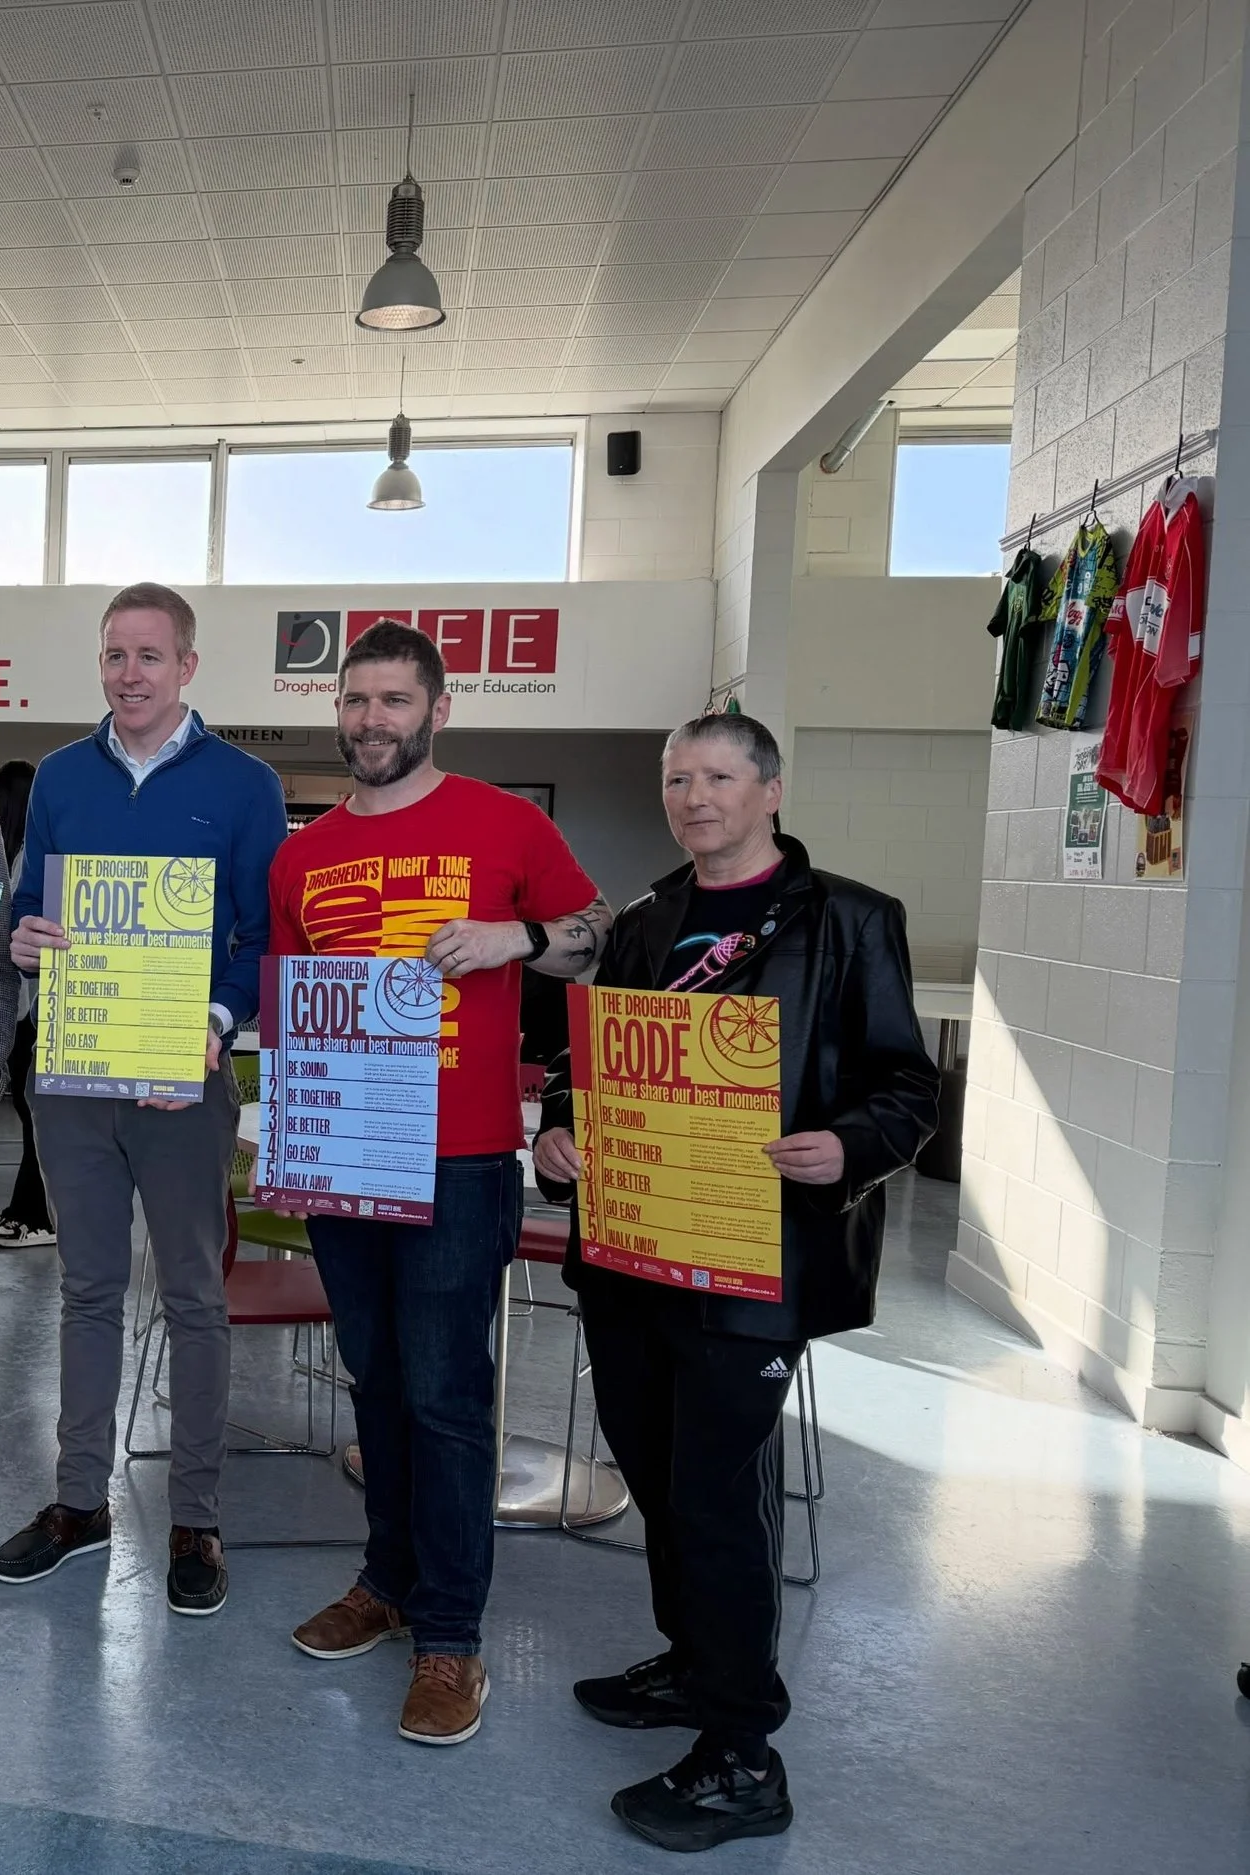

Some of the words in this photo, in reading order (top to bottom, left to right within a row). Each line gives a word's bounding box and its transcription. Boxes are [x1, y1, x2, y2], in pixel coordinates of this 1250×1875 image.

[285, 612, 541, 668] DFE
[274, 679, 337, 696] Droghed
[445, 680, 480, 693] rther
[483, 679, 556, 693] Education
[213, 729, 283, 741] ANTEEN
[75, 859, 93, 876] THE
[96, 859, 149, 879] DROGHEDA
[307, 860, 380, 892] DROGHEDA'S
[388, 856, 430, 878] NIGHT
[438, 856, 472, 878] TIME
[424, 877, 470, 900] VISION
[73, 879, 148, 930] CODE
[69, 929, 87, 944] how
[89, 932, 101, 944] we
[103, 931, 129, 946] share
[130, 934, 144, 946] our
[147, 932, 166, 947] best
[169, 933, 212, 949] moments
[69, 954, 79, 968] BE
[81, 955, 107, 969] SOUND
[291, 961, 309, 978] THE
[313, 961, 369, 980] DROGHEDA
[67, 981, 78, 994] BE
[79, 982, 119, 997] TOGETHER
[291, 982, 368, 1034] CODE
[601, 993, 622, 1014] THE
[626, 995, 691, 1020] DROGHEDA
[65, 1034, 76, 1047] GO
[78, 1034, 97, 1049] EASY
[289, 1034, 307, 1050] how
[309, 1037, 322, 1050] we
[324, 1036, 350, 1052] share
[352, 1039, 367, 1053] our
[370, 1038, 390, 1054] best
[393, 1039, 439, 1057] moments
[603, 1017, 691, 1083] CODE
[64, 1060, 85, 1074] WALK
[88, 1061, 110, 1076] AWAY
[289, 1061, 299, 1075] BE
[301, 1062, 329, 1077] SOUND
[288, 1089, 298, 1103] BE
[299, 1090, 341, 1107] TOGETHER
[601, 1078, 619, 1096] how
[622, 1082, 637, 1098] we
[640, 1082, 671, 1102] share
[673, 1087, 691, 1104] our
[695, 1087, 719, 1107] best
[723, 1090, 779, 1113] moments
[287, 1116, 297, 1131] BE
[299, 1118, 329, 1134] BETTER
[603, 1106, 614, 1123] BE
[616, 1108, 646, 1128] SOUND
[286, 1145, 297, 1159] GO
[299, 1145, 319, 1162] EASY
[604, 1138, 614, 1155] BE
[616, 1140, 662, 1163] TOGETHER
[285, 1172, 307, 1189] WALK
[309, 1175, 332, 1192] AWAY
[605, 1168, 615, 1184] BE
[617, 1170, 650, 1192] BETTER
[606, 1198, 617, 1215] GO
[620, 1200, 641, 1222] EASY
[608, 1229, 630, 1250] WALK
[633, 1233, 658, 1255] AWAY
